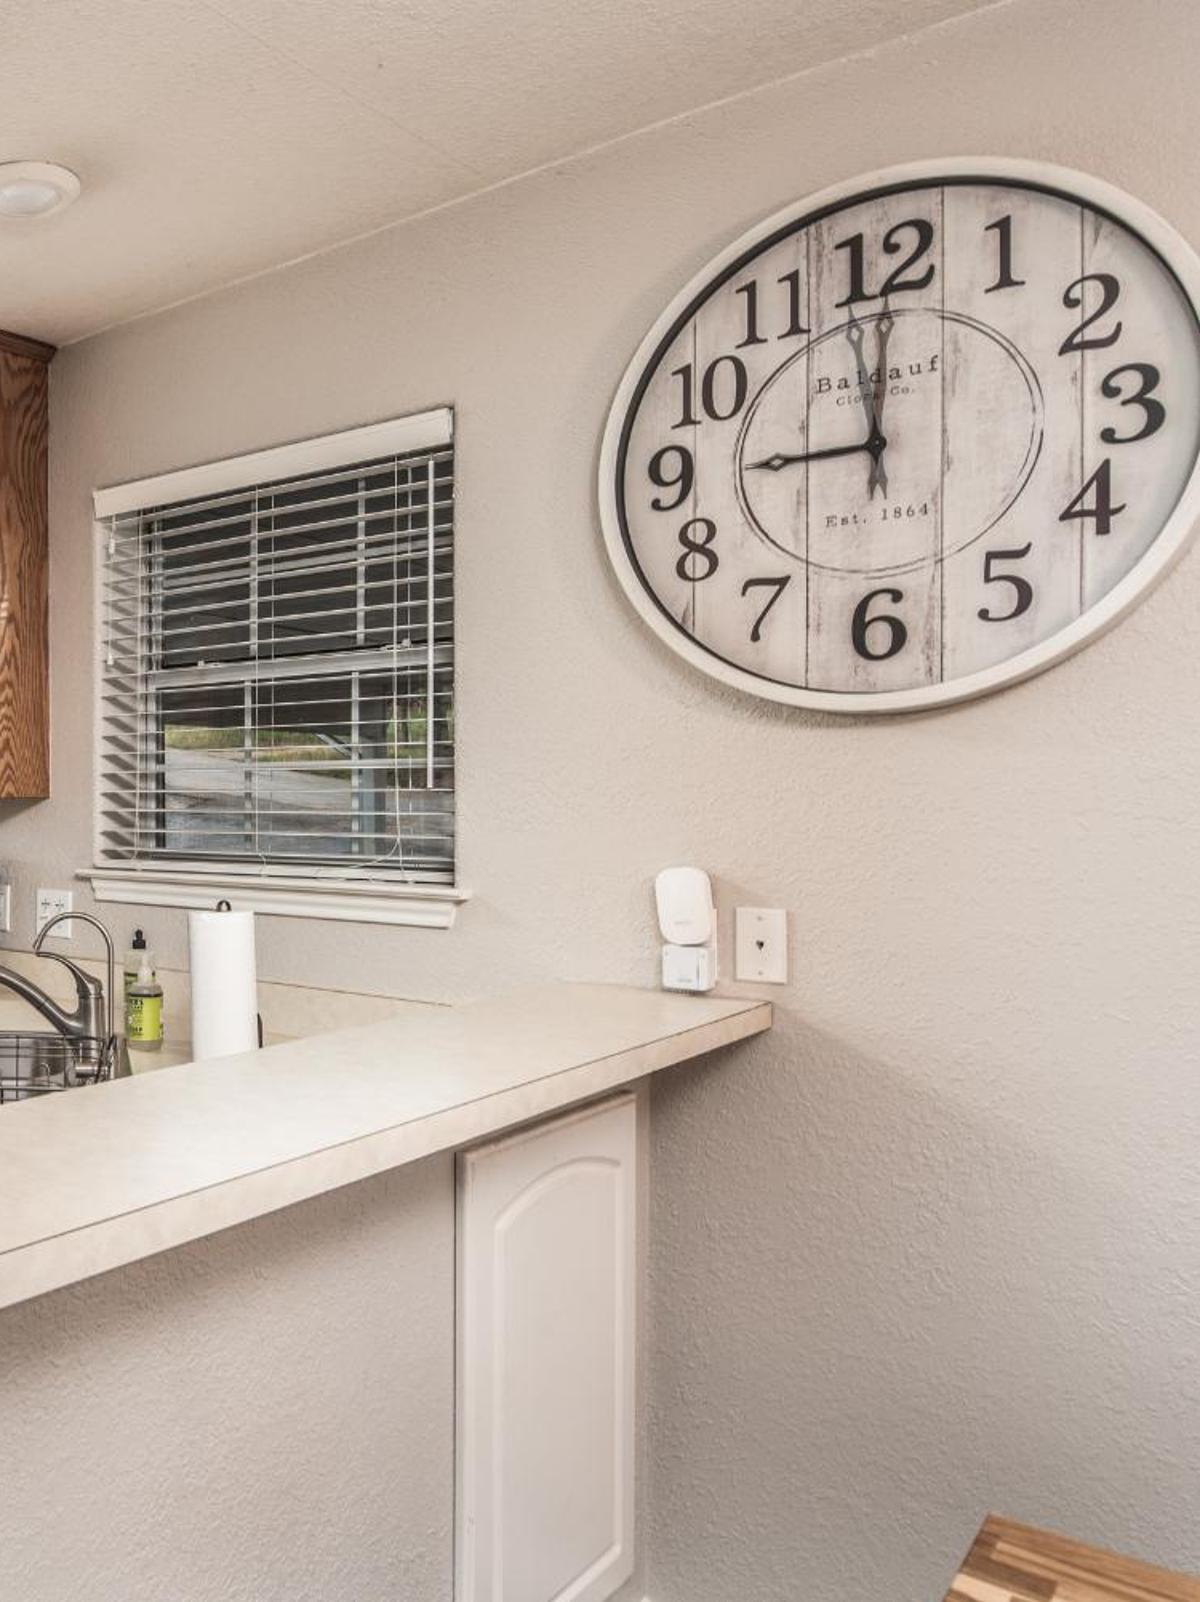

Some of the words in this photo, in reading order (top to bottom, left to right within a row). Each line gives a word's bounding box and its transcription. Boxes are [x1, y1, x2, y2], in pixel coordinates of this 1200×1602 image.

[833, 218, 936, 310] 12
[984, 214, 1026, 294] 1
[734, 267, 812, 350] 11
[1058, 272, 1122, 357] 2
[670, 355, 749, 430] 10
[814, 354, 939, 395] Baldauf
[1100, 362, 1167, 445] 3
[647, 444, 696, 513] 9
[881, 502, 929, 521] 1864
[1058, 457, 1127, 537] 4
[675, 517, 720, 583] 8
[977, 541, 1034, 622] 5
[740, 575, 792, 643] 7
[850, 587, 909, 662] 6
